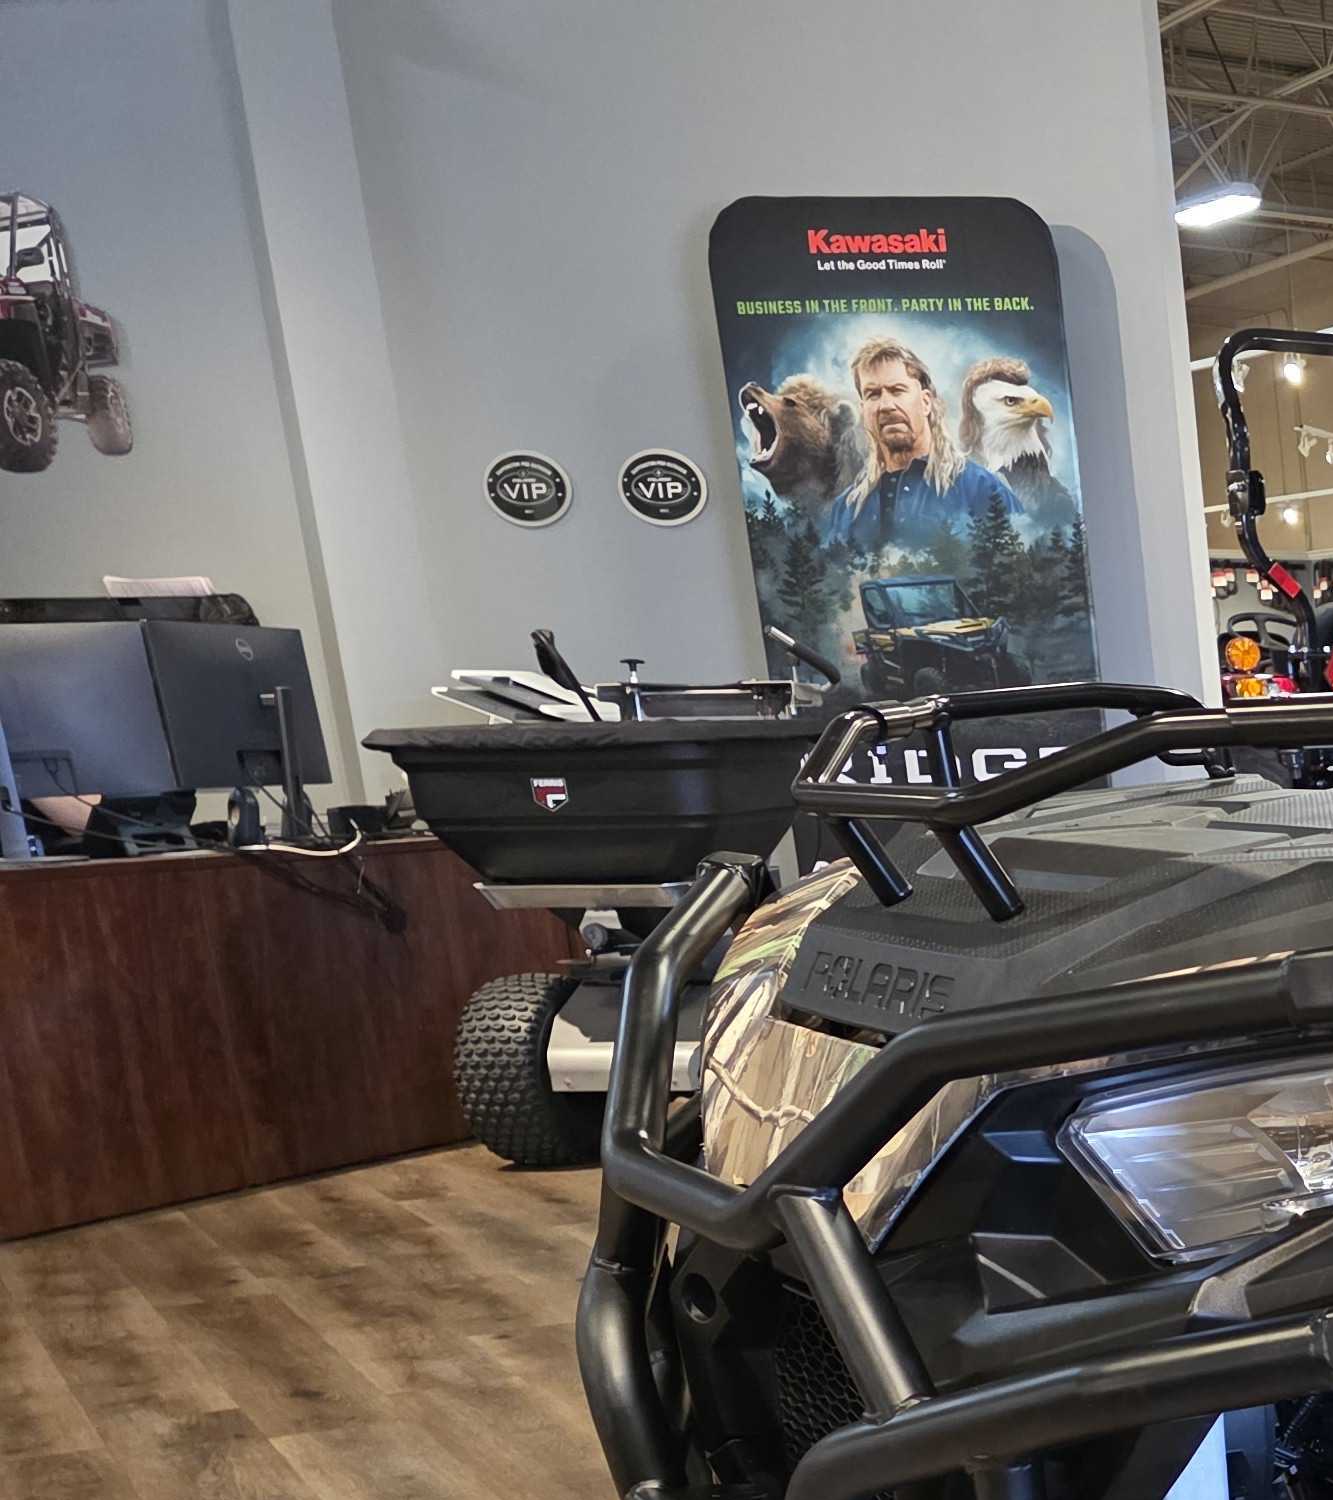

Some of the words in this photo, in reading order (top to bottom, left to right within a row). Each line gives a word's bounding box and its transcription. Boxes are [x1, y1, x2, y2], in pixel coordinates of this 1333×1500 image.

[808, 228, 947, 254] Kawasaki
[817, 259, 834, 271] Let
[837, 259, 855, 270] the
[856, 259, 886, 270] Good
[887, 259, 921, 270] Times
[736, 300, 802, 315] BUSINESS
[805, 300, 820, 313] IN
[822, 299, 849, 313] THE
[851, 298, 899, 313] FRONT.
[902, 298, 944, 312] PARTY
[948, 298, 963, 312] IN
[964, 297, 992, 311] THE
[994, 296, 1035, 311] BACK.
[503, 483, 547, 499] VIP
[638, 481, 683, 499] VIP
[801, 951, 956, 1019] POLARIS
